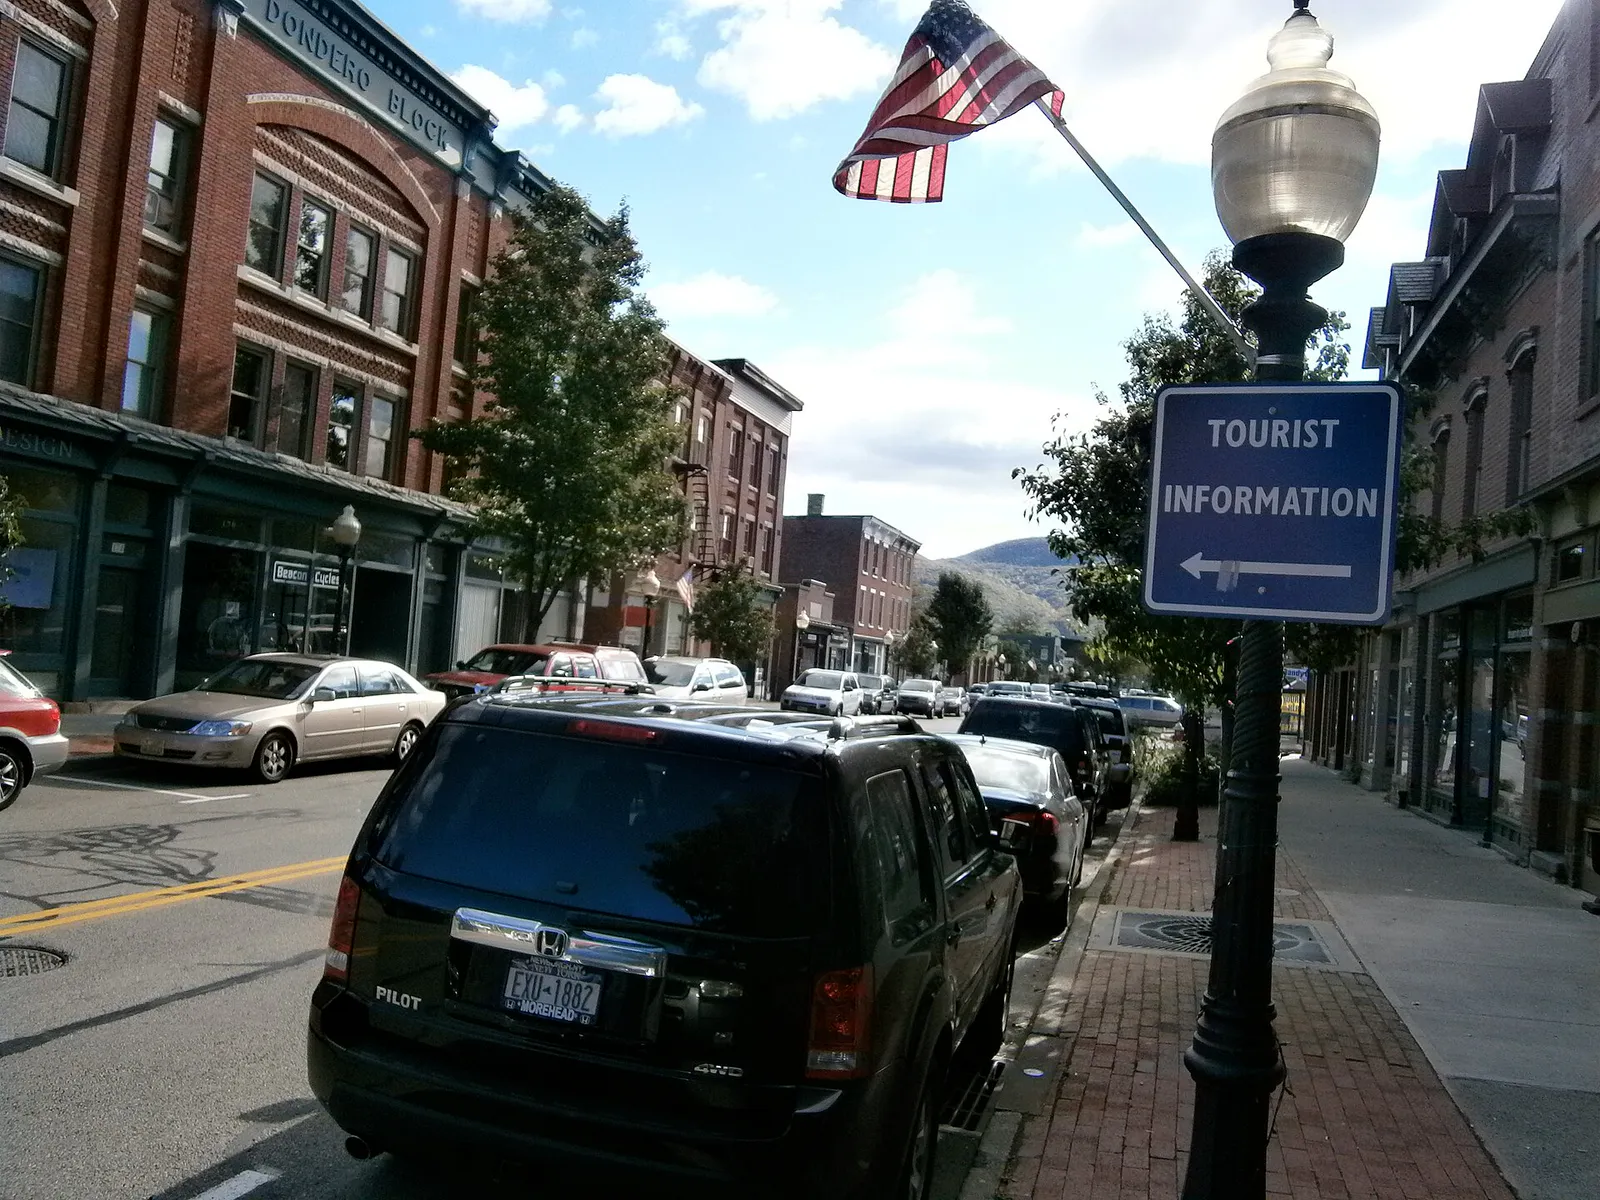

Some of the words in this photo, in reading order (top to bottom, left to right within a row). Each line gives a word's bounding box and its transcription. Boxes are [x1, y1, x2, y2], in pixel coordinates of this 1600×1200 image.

[265, 0, 370, 91] DONDERO
[388, 88, 448, 151] BLOCK
[0, 425, 73, 458] ESIGN
[1207, 419, 1340, 448] TOURIST
[1164, 484, 1378, 518] INFORMATION
[276, 565, 308, 581] Beacon
[314, 571, 340, 586] Cycles
[376, 985, 422, 1010] PILOT
[511, 971, 543, 1001] EXU
[554, 979, 593, 1012] 1882
[520, 1000, 575, 1021] MOREHEAD
[694, 1063, 743, 1077] 4WD
